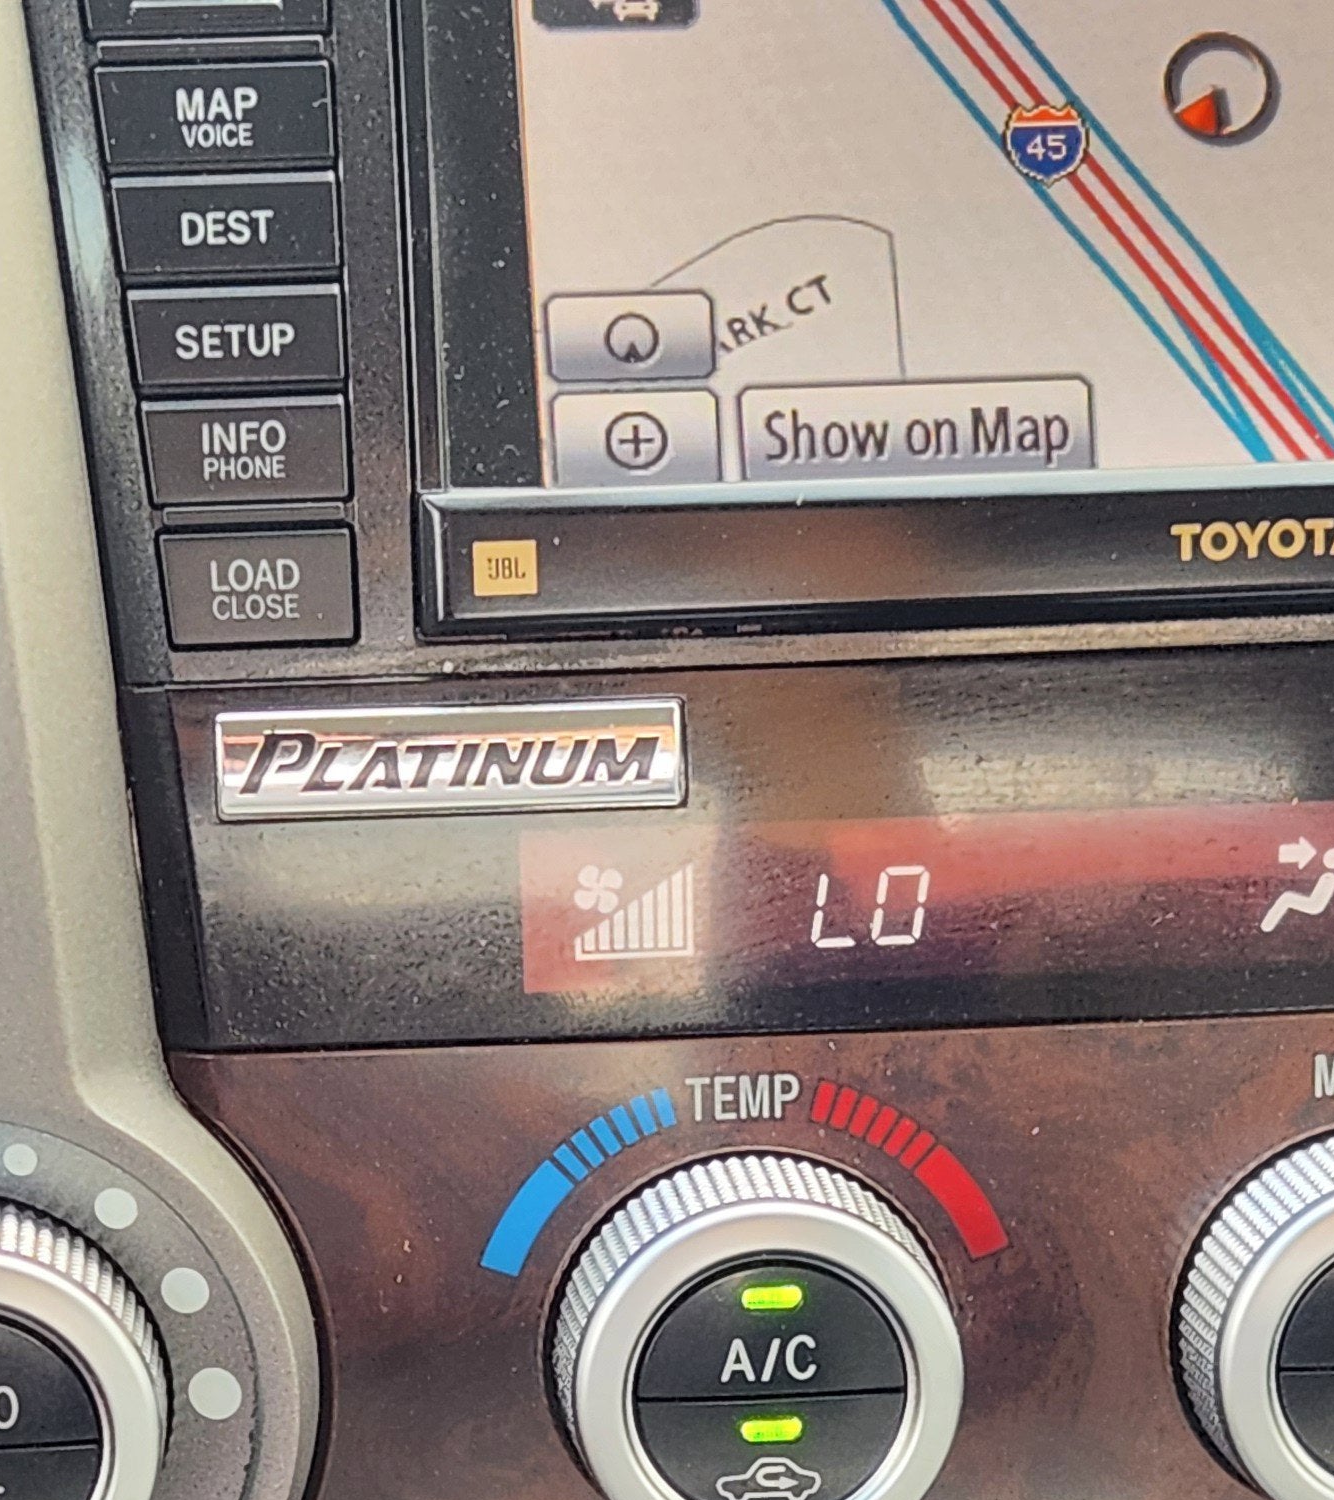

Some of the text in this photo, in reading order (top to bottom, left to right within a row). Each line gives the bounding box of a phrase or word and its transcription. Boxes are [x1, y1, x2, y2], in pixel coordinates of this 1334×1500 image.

[175, 87, 259, 123] MAP
[180, 122, 255, 149] VOICE
[1025, 133, 1067, 162] 45
[180, 208, 276, 247] DEST
[785, 273, 832, 315] CT
[175, 323, 296, 360] SETUP
[201, 419, 287, 455] INFO
[763, 405, 1071, 462] Show on Map
[202, 455, 287, 482] PHONE
[210, 557, 301, 594] LOAD
[486, 556, 526, 580] JBL
[212, 593, 300, 622] CLOSE
[238, 730, 661, 796] PLATINUM
[684, 1074, 801, 1123] TEMP
[720, 1333, 819, 1385] A/C
